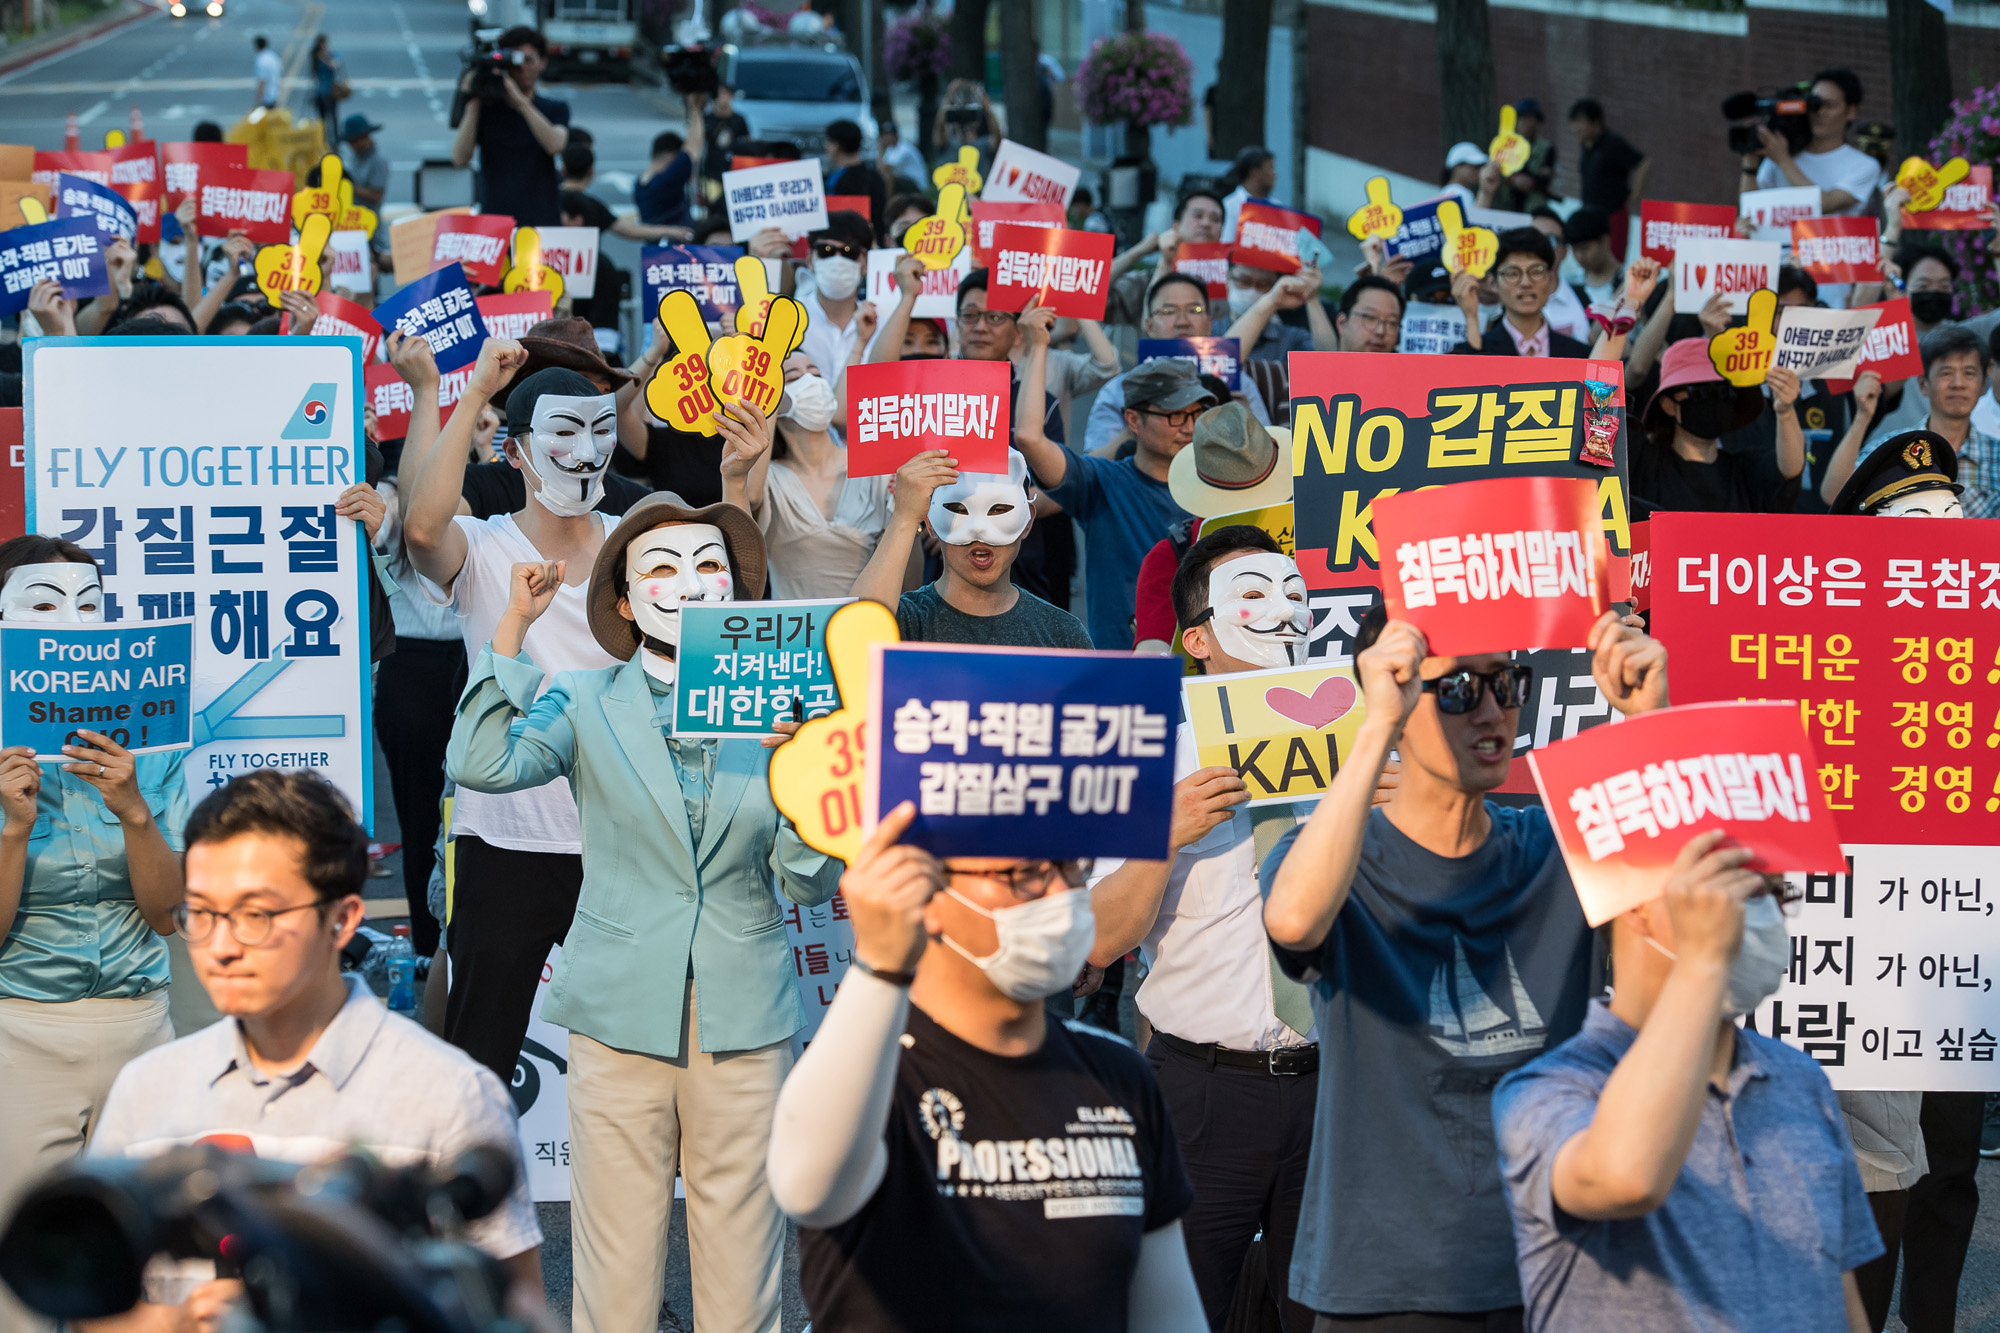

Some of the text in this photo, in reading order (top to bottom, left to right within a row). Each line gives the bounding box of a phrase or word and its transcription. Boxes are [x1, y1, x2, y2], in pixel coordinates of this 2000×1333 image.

[995, 161, 1007, 186] I
[201, 185, 288, 224] 침묵하지말자!
[311, 193, 330, 210] 39
[923, 219, 944, 237] 39
[1457, 232, 1476, 250] 39
[0, 240, 53, 271] 객·직원
[914, 236, 956, 254] OUT!
[62, 257, 90, 280] OUT
[647, 263, 705, 285] 승객·직원
[875, 271, 881, 296] I
[996, 249, 1104, 295] 침묵하지말자!
[1683, 263, 1768, 293] I ASIANA
[712, 286, 736, 304] OUT
[1735, 331, 1759, 351] 39
[1784, 326, 1834, 347] 아름다운
[673, 353, 707, 391] 39
[741, 345, 770, 377] 39
[1725, 349, 1771, 372] OUT!
[722, 370, 775, 411] OUT!
[858, 393, 999, 443] 침묵하지말자!
[1293, 388, 1578, 476] No 갑질
[47, 447, 128, 488] FLY
[137, 446, 350, 487] TOGETHER
[60, 505, 339, 576] 갑질근절
[1396, 530, 1597, 610] 침묵하지말자!
[1677, 553, 1867, 606] 더이상은
[103, 588, 341, 660] 해요
[719, 612, 815, 650] 우리가
[39, 636, 156, 662] Proud of
[713, 650, 823, 681] 지켜낸다!
[1730, 633, 1860, 681] 더러운
[10, 664, 186, 694] KOREAN AIR
[28, 698, 175, 724] Shame on
[1217, 685, 1235, 735] I
[893, 698, 1167, 757] 승객·직원 굶기는
[209, 752, 329, 769] FLY TOGETHER
[919, 762, 1063, 816] 갑질삼구
[1068, 765, 1139, 815] OUT
[1567, 752, 1811, 862] 침묵하지말자!
[1878, 877, 1909, 912] 가
[1921, 878, 1994, 917] 아닌,
[1876, 953, 1907, 987] 가
[1919, 954, 1992, 993] 아닌,
[1861, 1027, 1923, 1060] 이고
[937, 1137, 1142, 1183] PROFESSIONAL
